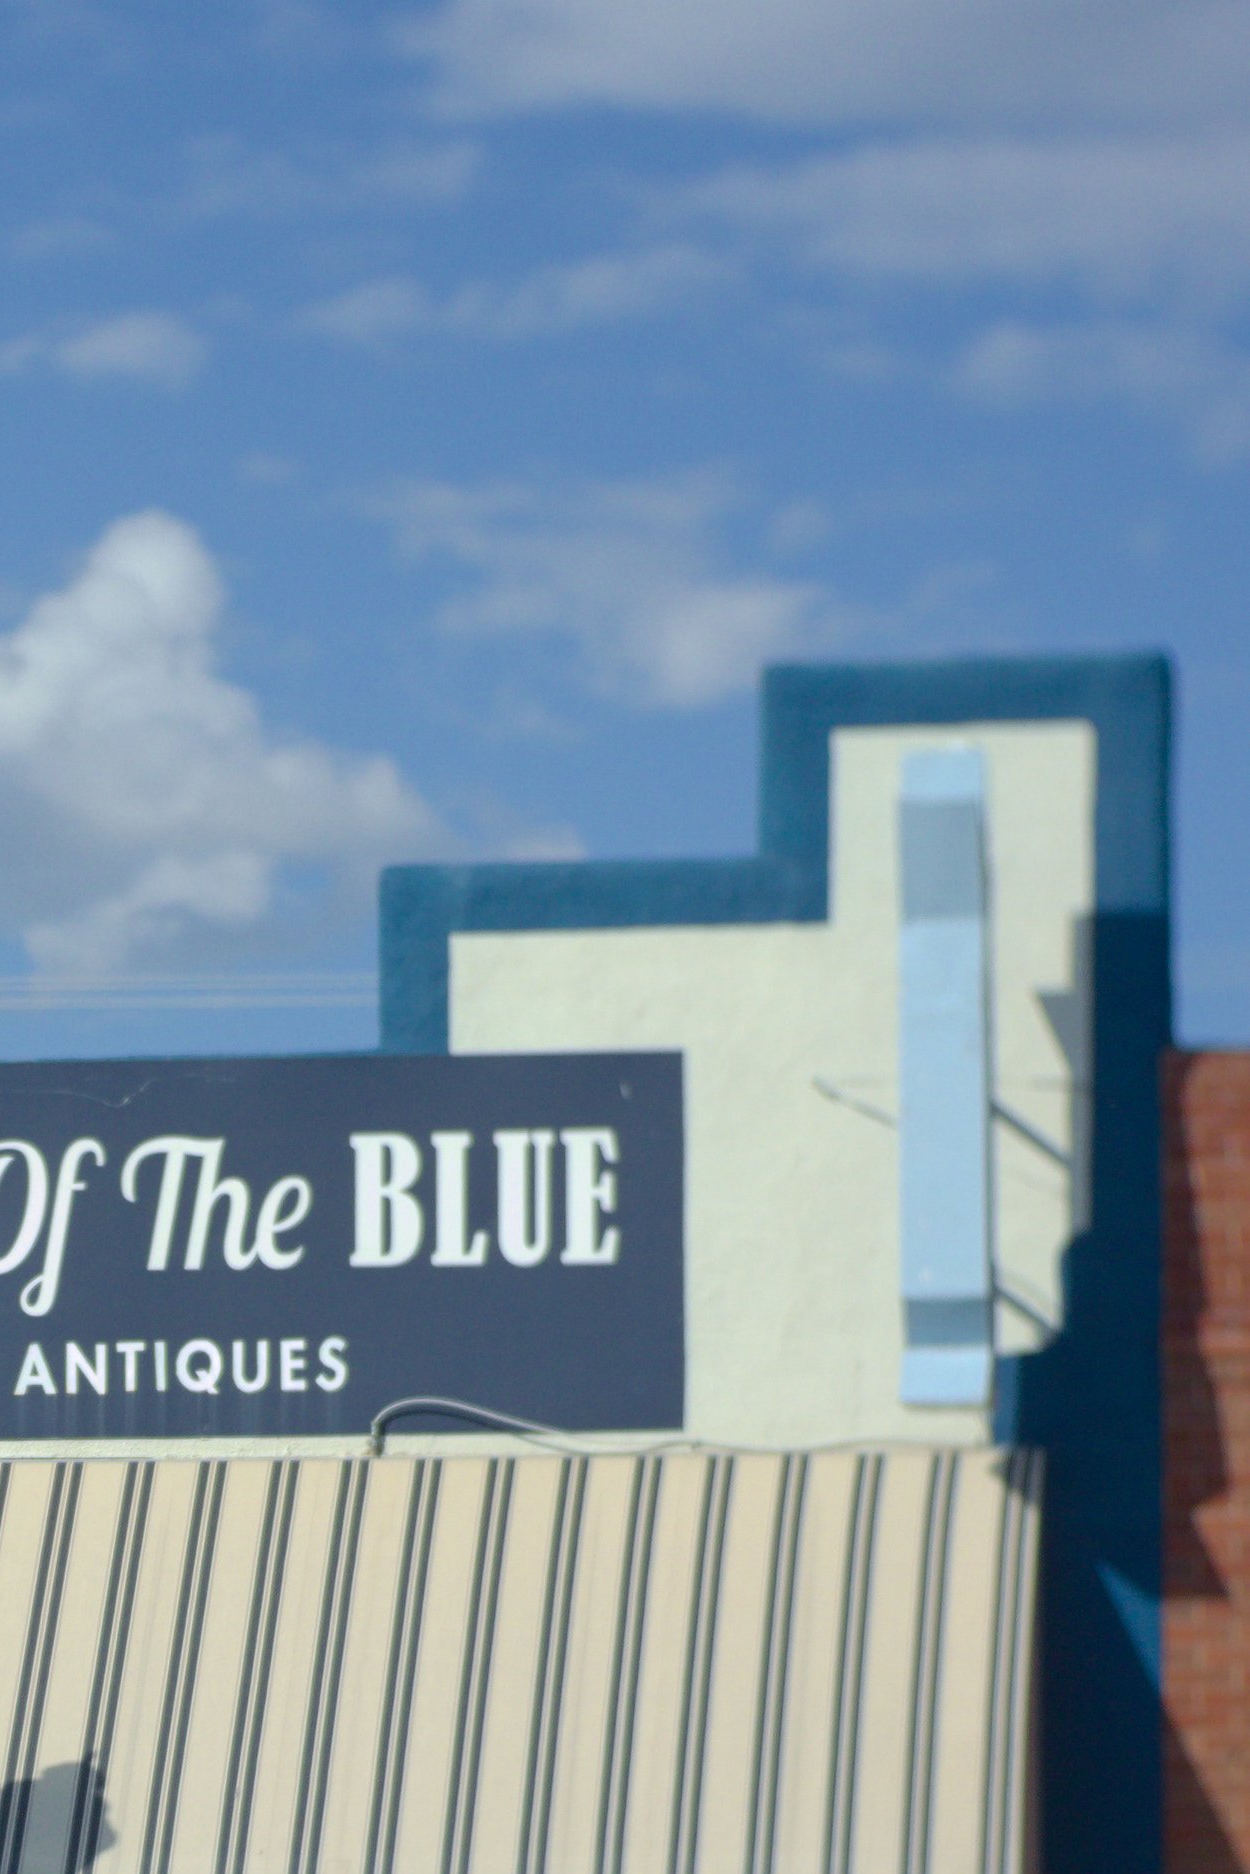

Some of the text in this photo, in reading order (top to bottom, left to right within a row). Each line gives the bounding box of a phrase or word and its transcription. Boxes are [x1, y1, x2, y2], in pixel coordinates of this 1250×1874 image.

[121, 1135, 312, 1272] The
[349, 1128, 620, 1268] BLUE
[13, 1336, 348, 1397] ANTIQUES
